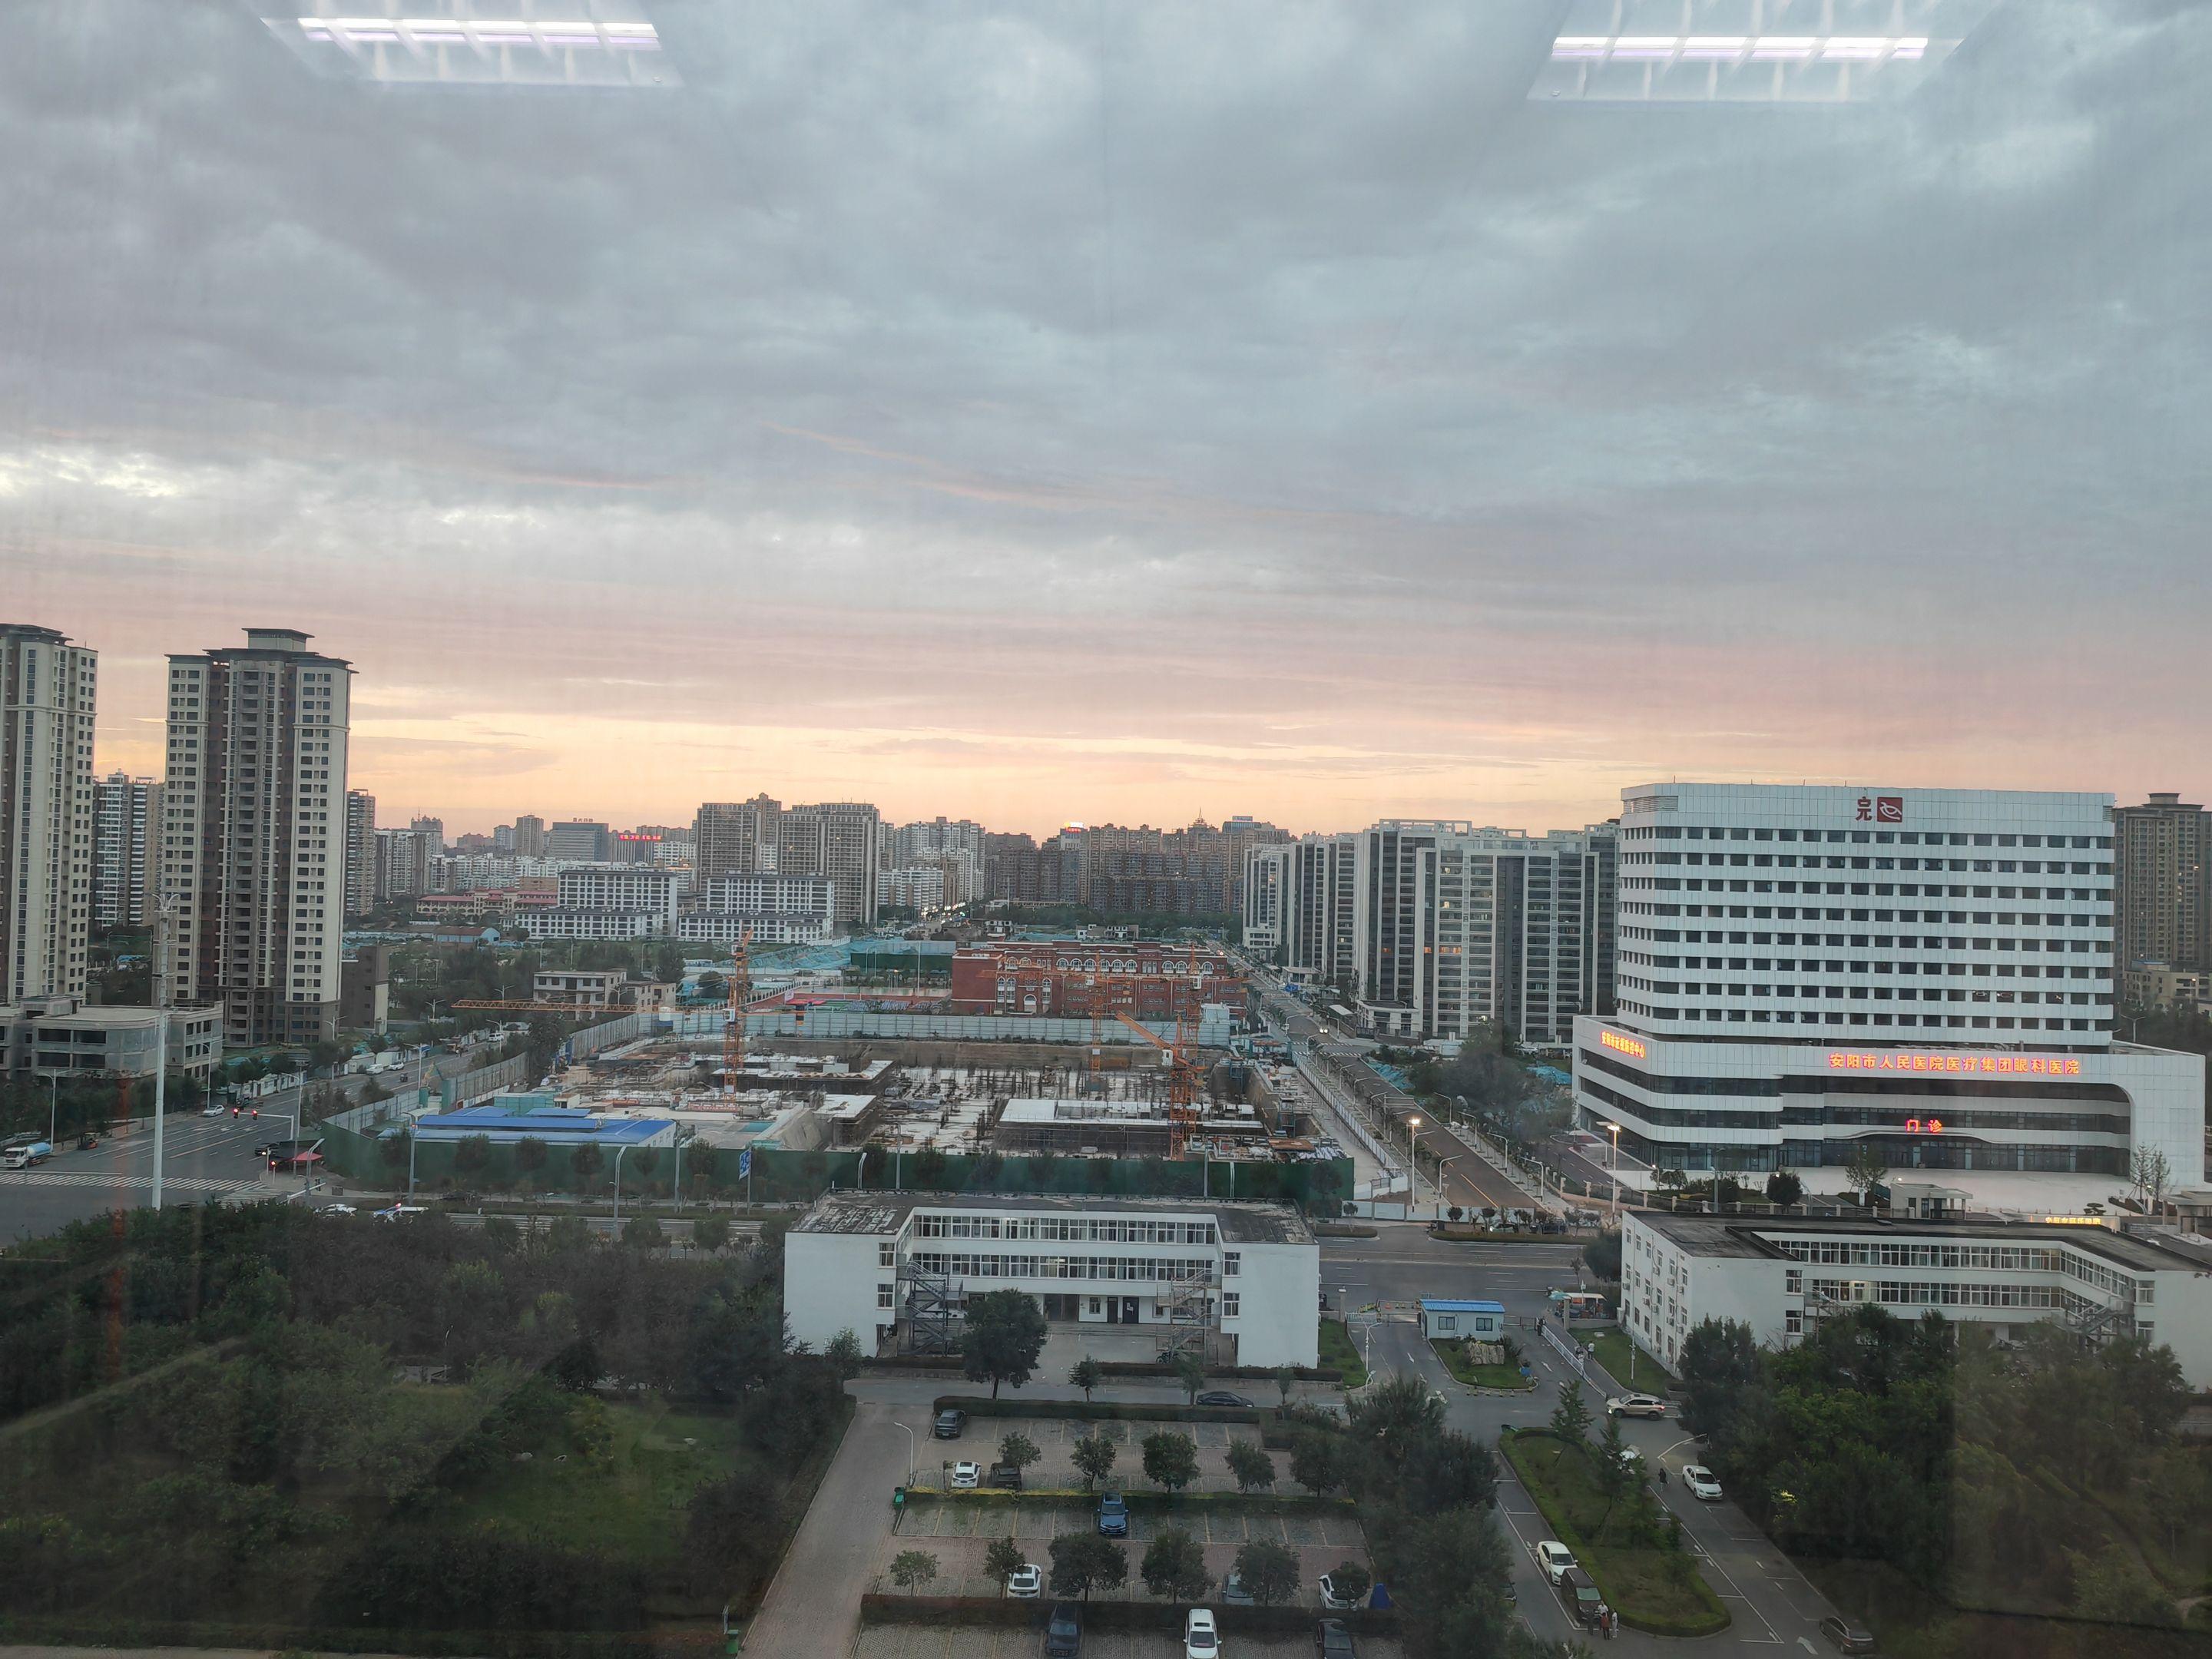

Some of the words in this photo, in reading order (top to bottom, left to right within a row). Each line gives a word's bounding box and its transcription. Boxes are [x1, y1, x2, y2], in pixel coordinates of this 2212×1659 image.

[1829, 1053, 2080, 1074] 安阳市人民医院医疗集团眼科医院
[1906, 1118, 1942, 1133] 门诊
